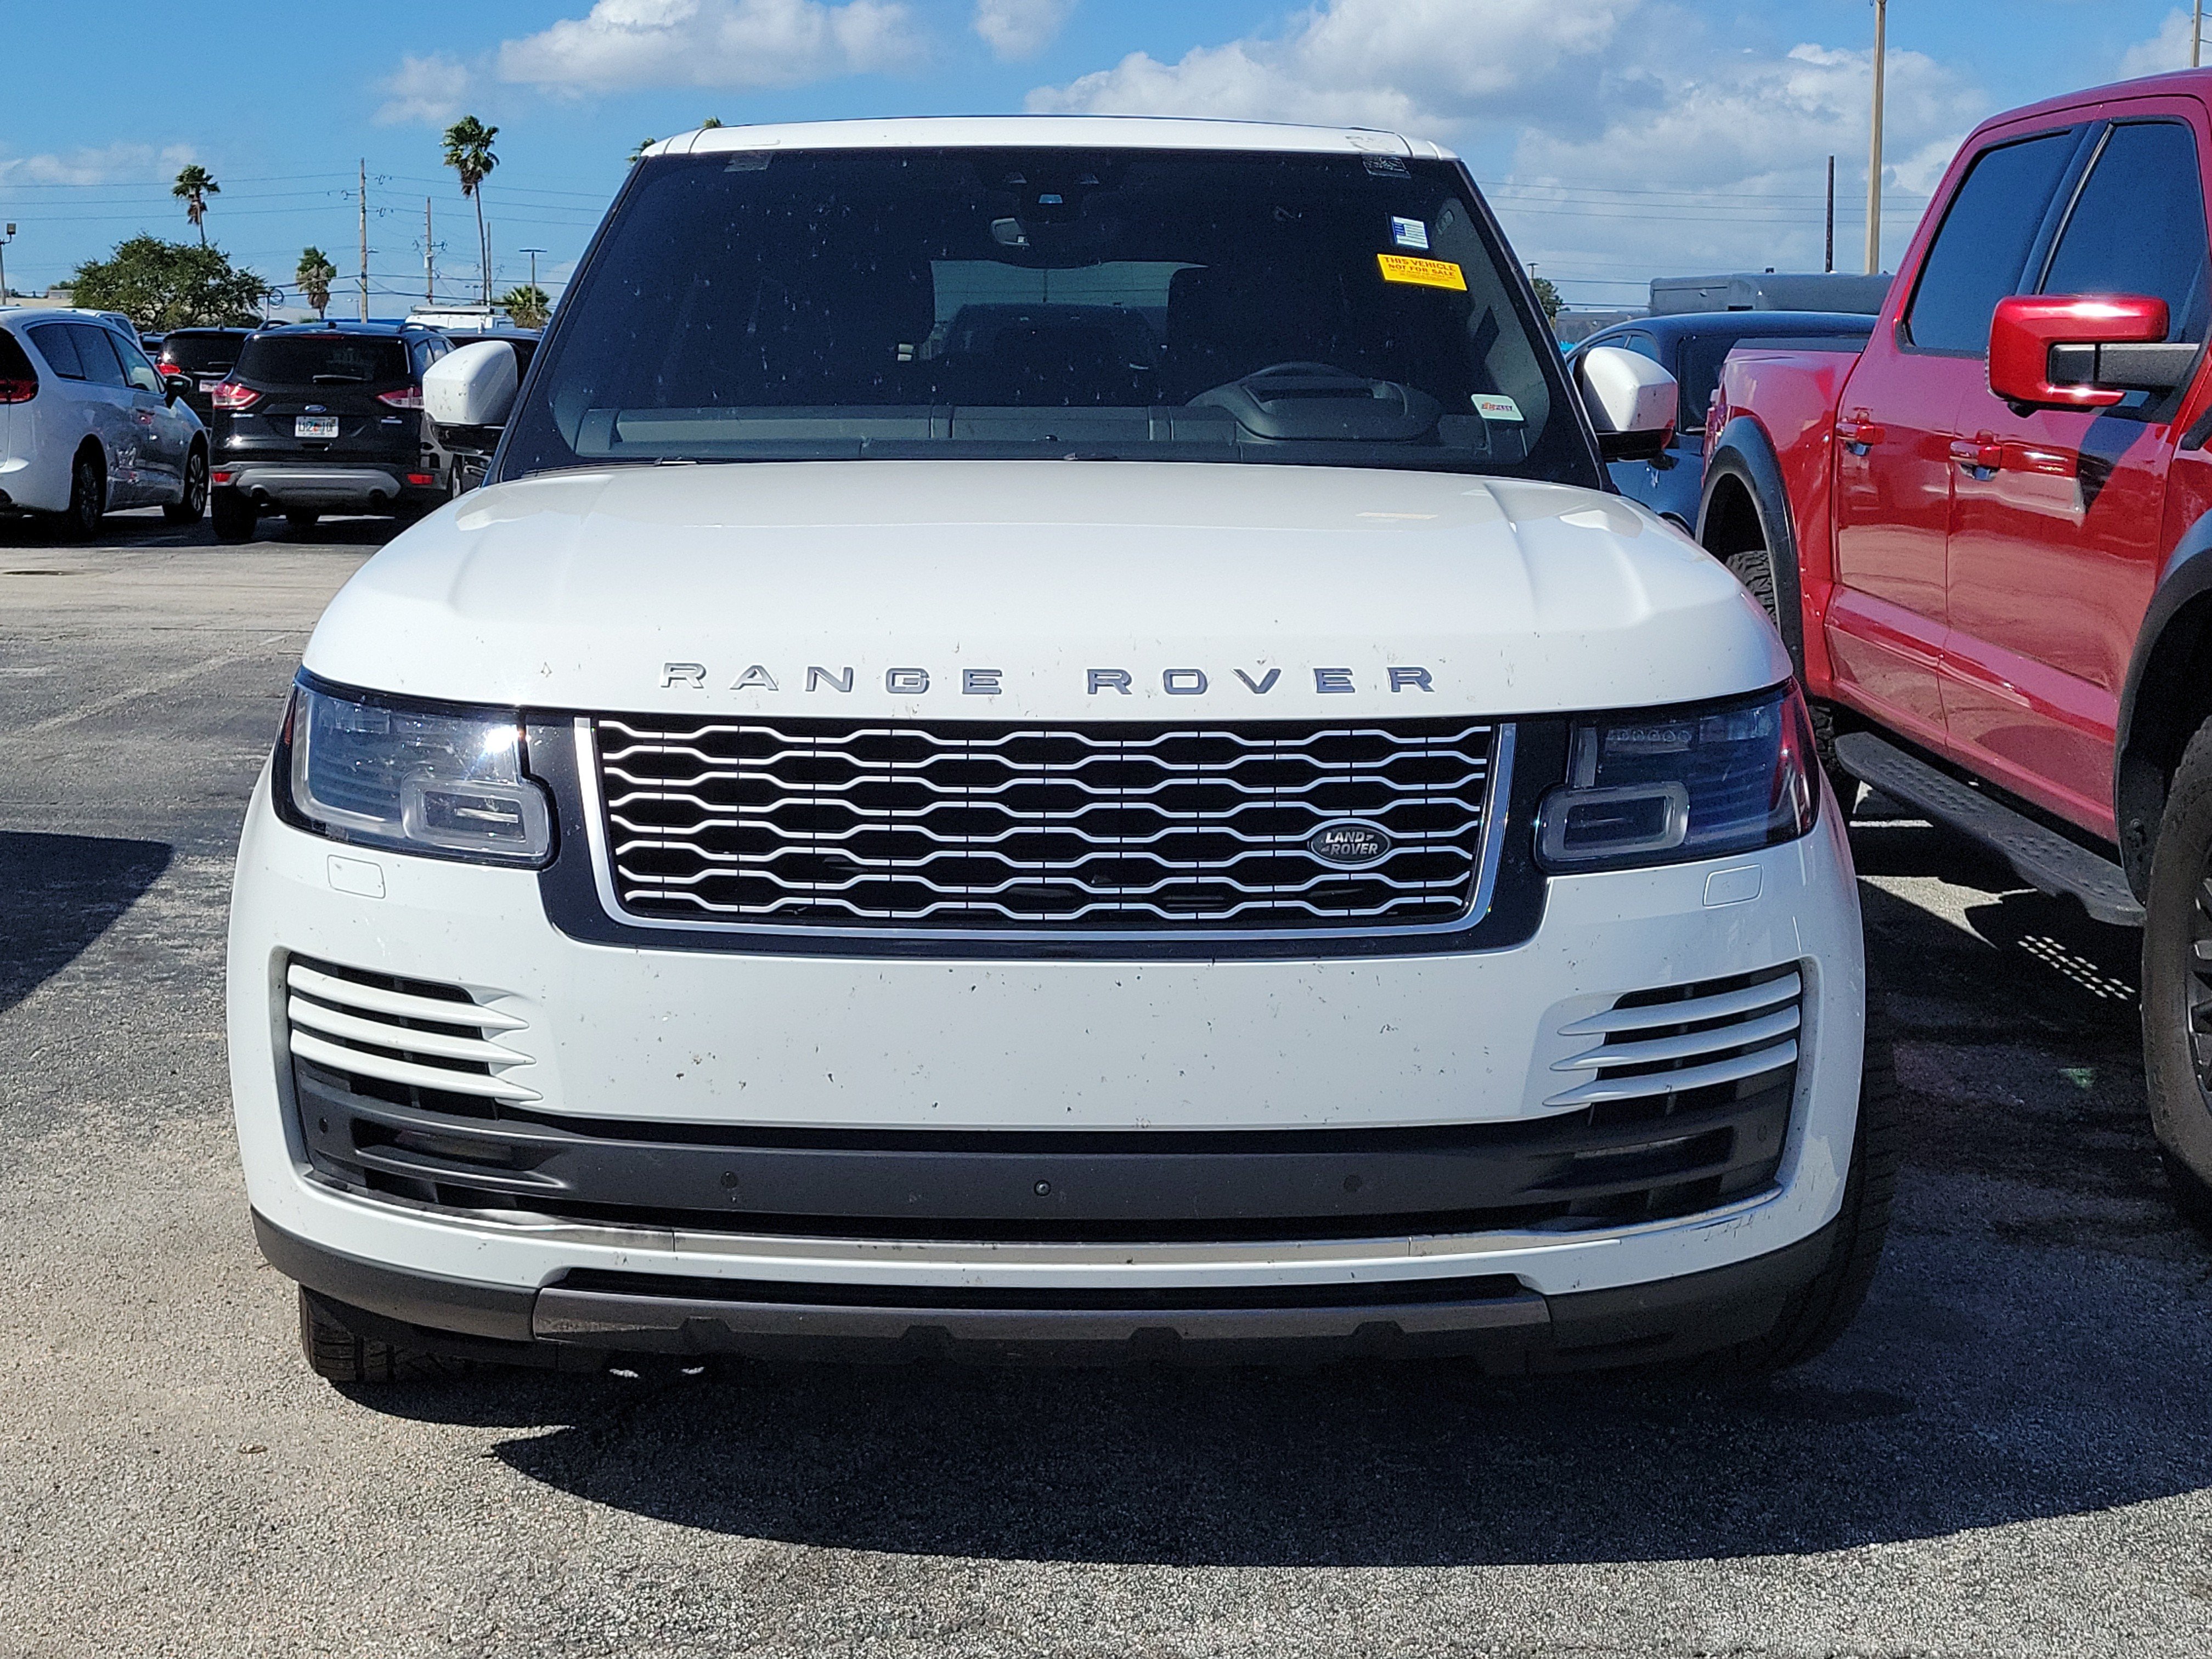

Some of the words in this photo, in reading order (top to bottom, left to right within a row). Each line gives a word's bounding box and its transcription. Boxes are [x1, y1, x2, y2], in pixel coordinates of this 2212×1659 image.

[1410, 259, 1456, 272] VEHICLE
[661, 662, 1002, 695] RANGE
[1087, 666, 1435, 695] ROVER
[1325, 832, 1365, 843] LAND
[1329, 843, 1379, 855] ROVER
